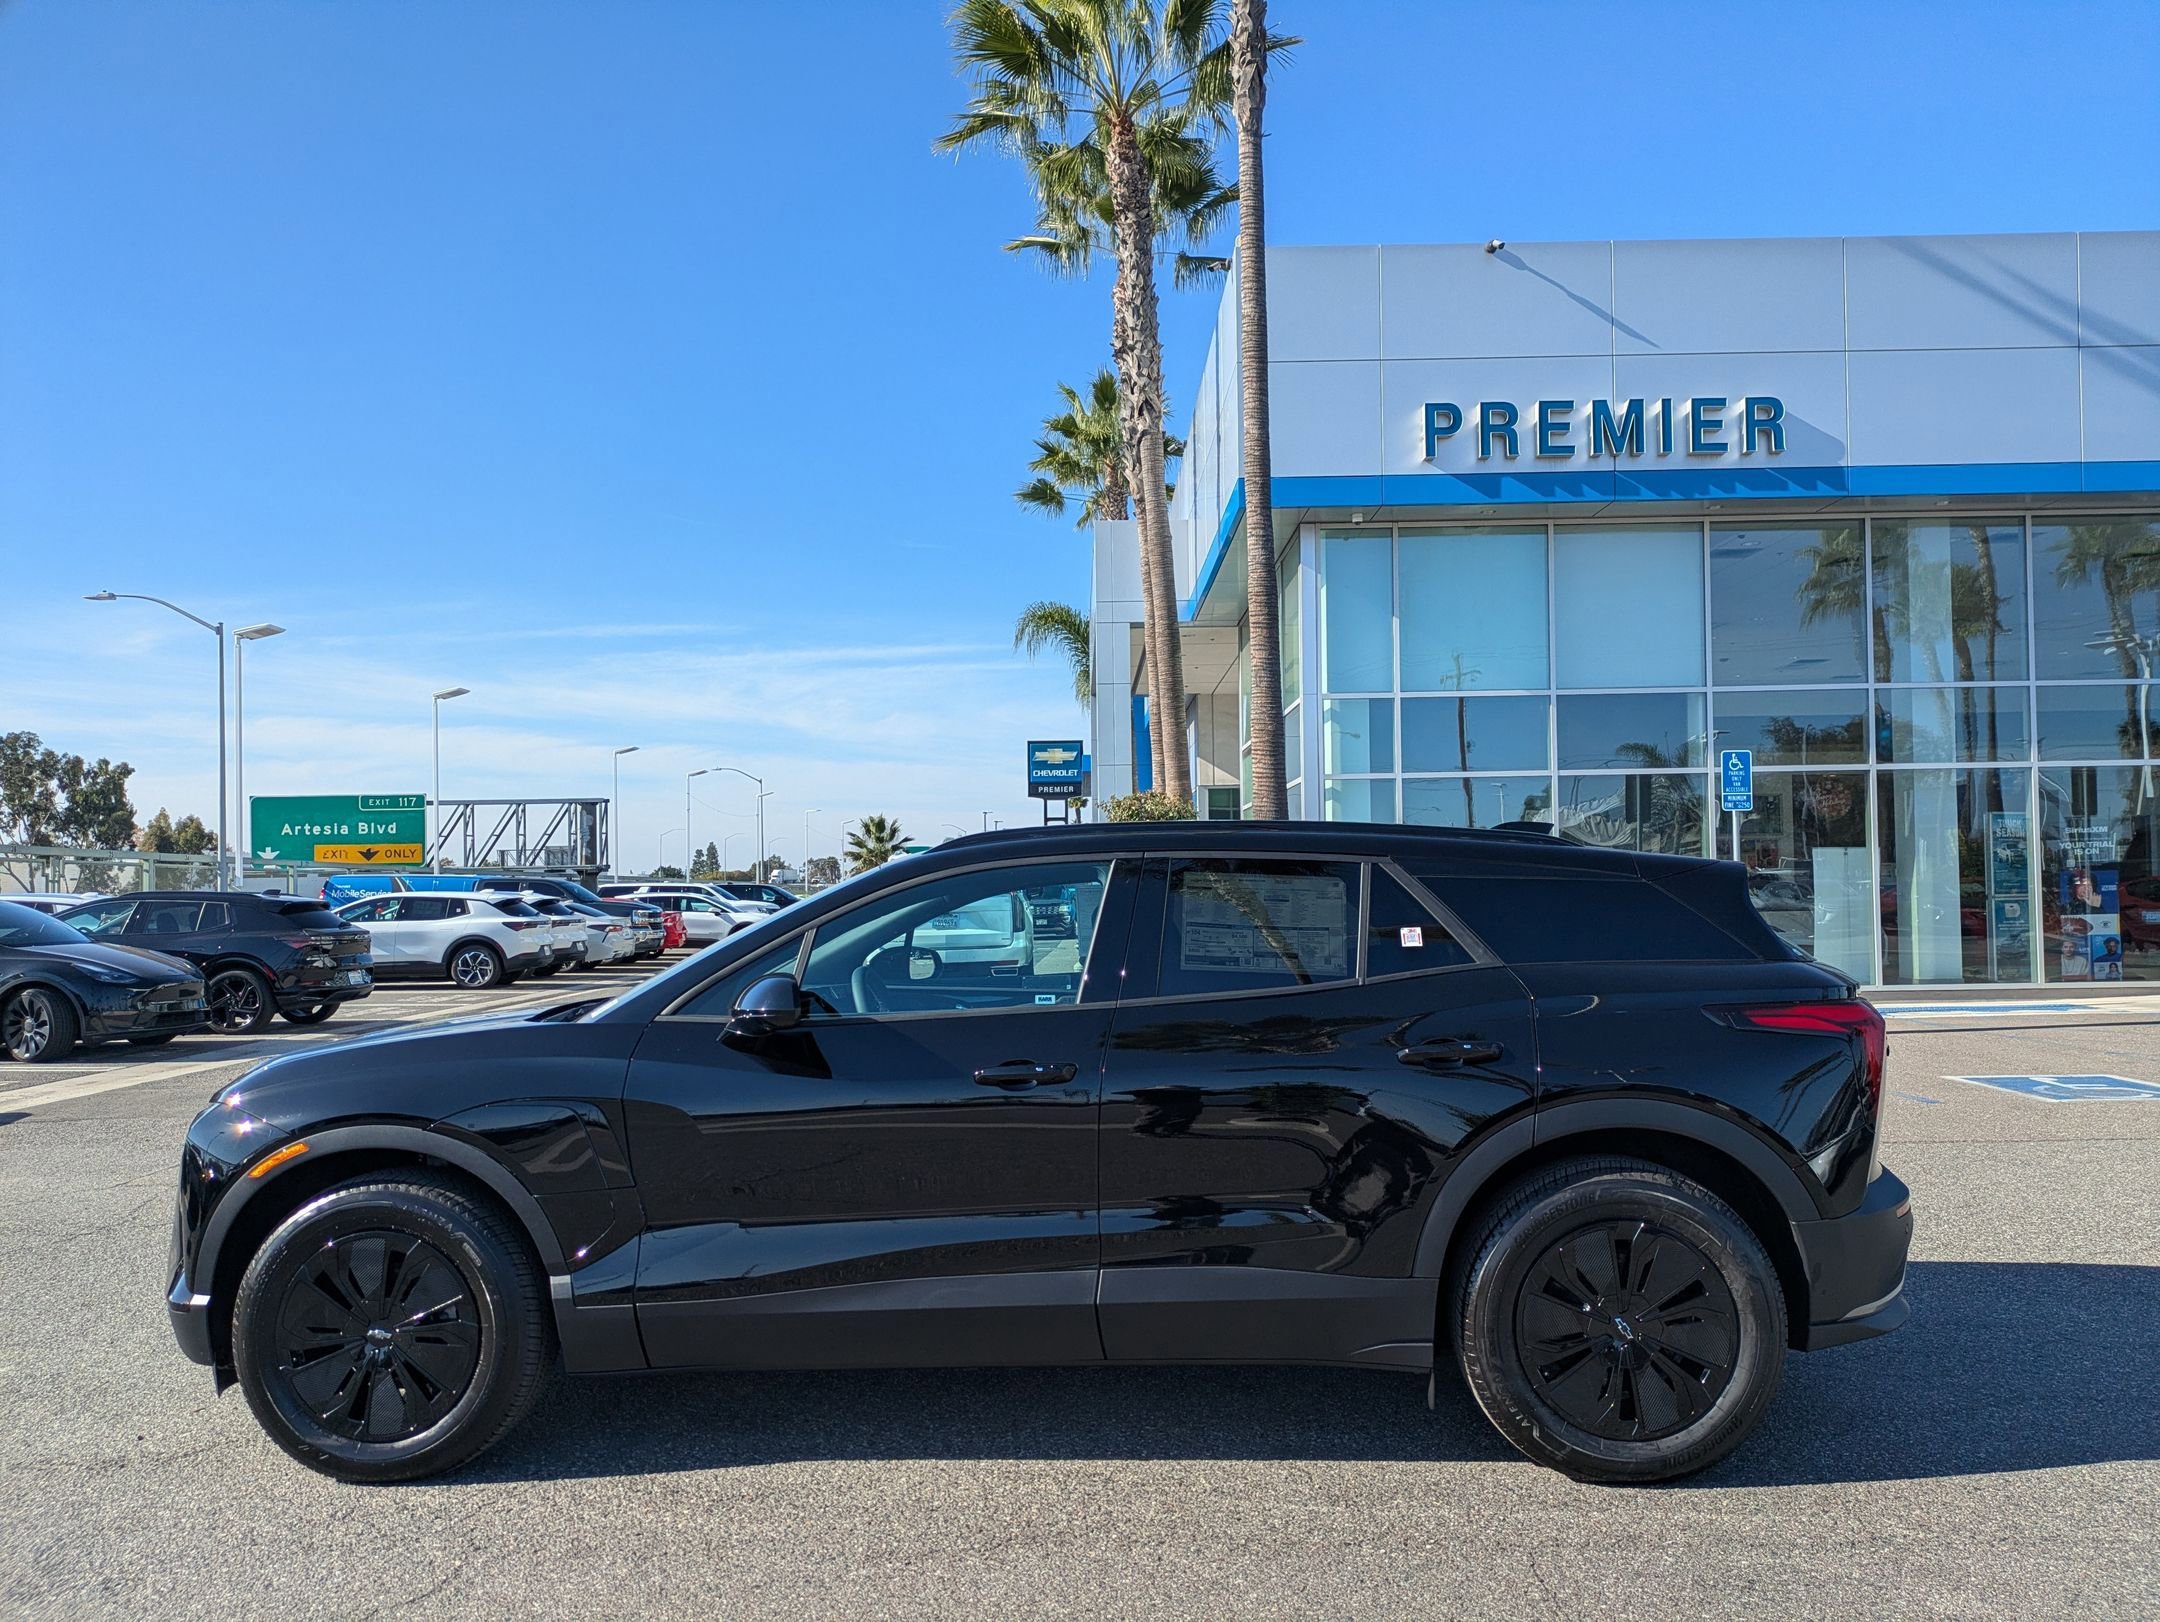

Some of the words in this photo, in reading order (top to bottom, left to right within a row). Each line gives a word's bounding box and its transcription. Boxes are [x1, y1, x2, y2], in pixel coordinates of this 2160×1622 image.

[1423, 396, 1786, 461] PREMIER
[1033, 769, 1078, 777] CHEVROLET
[1038, 785, 1074, 793] PREMIER
[368, 798, 390, 806] EXIT
[399, 797, 417, 807] 117
[281, 822, 349, 836] Artesia
[358, 821, 397, 835] Blvd
[384, 848, 417, 858] ONLY
